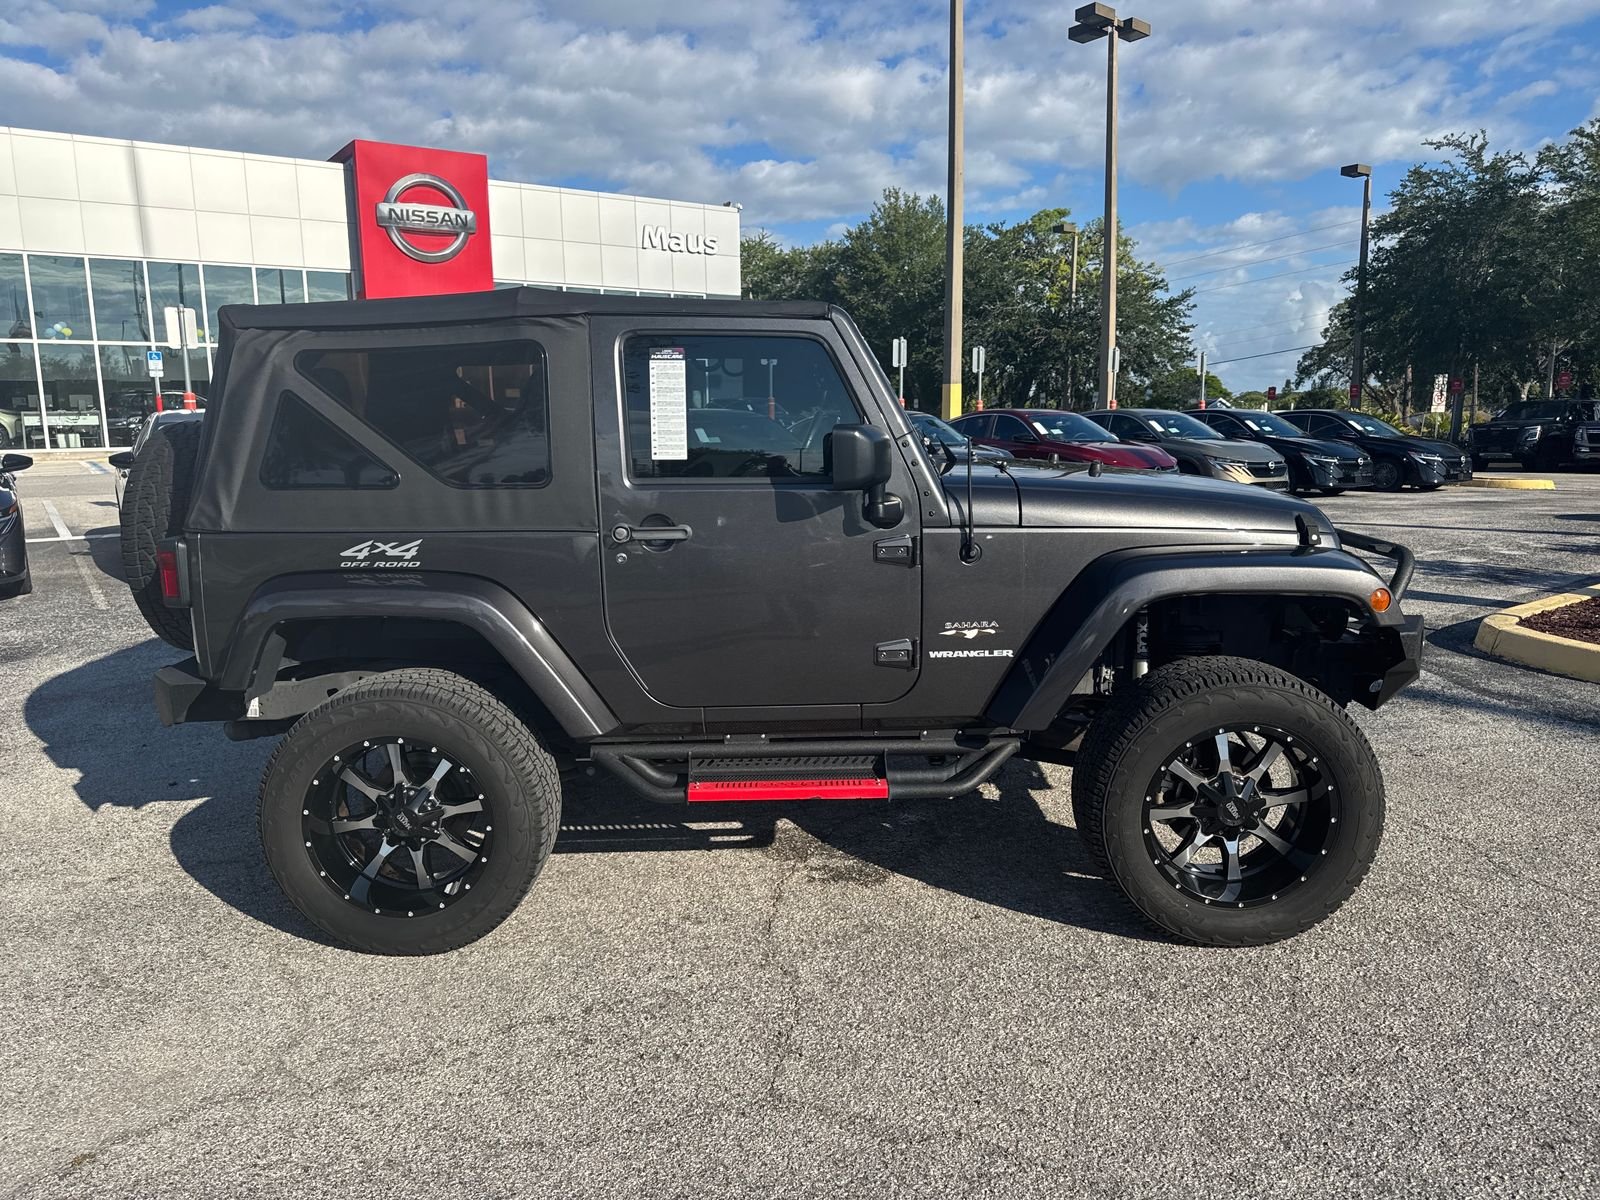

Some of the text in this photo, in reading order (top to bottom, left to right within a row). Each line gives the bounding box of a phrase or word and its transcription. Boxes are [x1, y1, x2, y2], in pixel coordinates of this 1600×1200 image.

[388, 207, 468, 227] NISSAN
[641, 223, 718, 256] Maus
[944, 620, 999, 629] SAHARA
[928, 649, 1014, 658] WRANGLER
